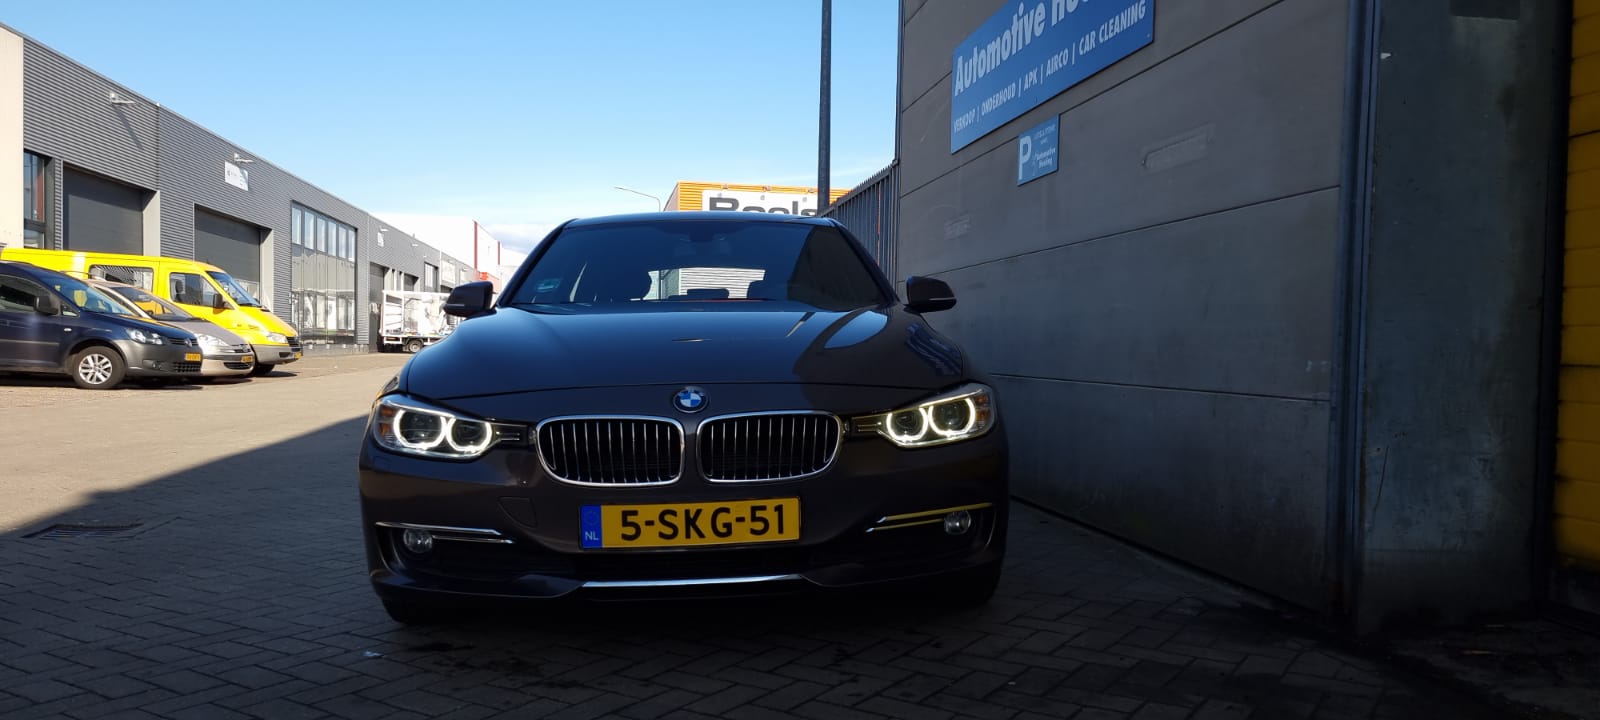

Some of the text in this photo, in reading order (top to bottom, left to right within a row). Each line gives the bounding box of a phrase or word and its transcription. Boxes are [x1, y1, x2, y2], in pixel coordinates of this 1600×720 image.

[954, 1, 1045, 96] Automotive
[981, 82, 1016, 116] ONDERHOUD
[1023, 67, 1038, 91] APK
[1046, 48, 1069, 77] AIRCO
[1079, 31, 1096, 56] CAR
[1098, 1, 1146, 44] CLEANING
[1019, 135, 1032, 180] P
[585, 531, 599, 541] NL
[621, 504, 784, 541] 5-SKG-51
